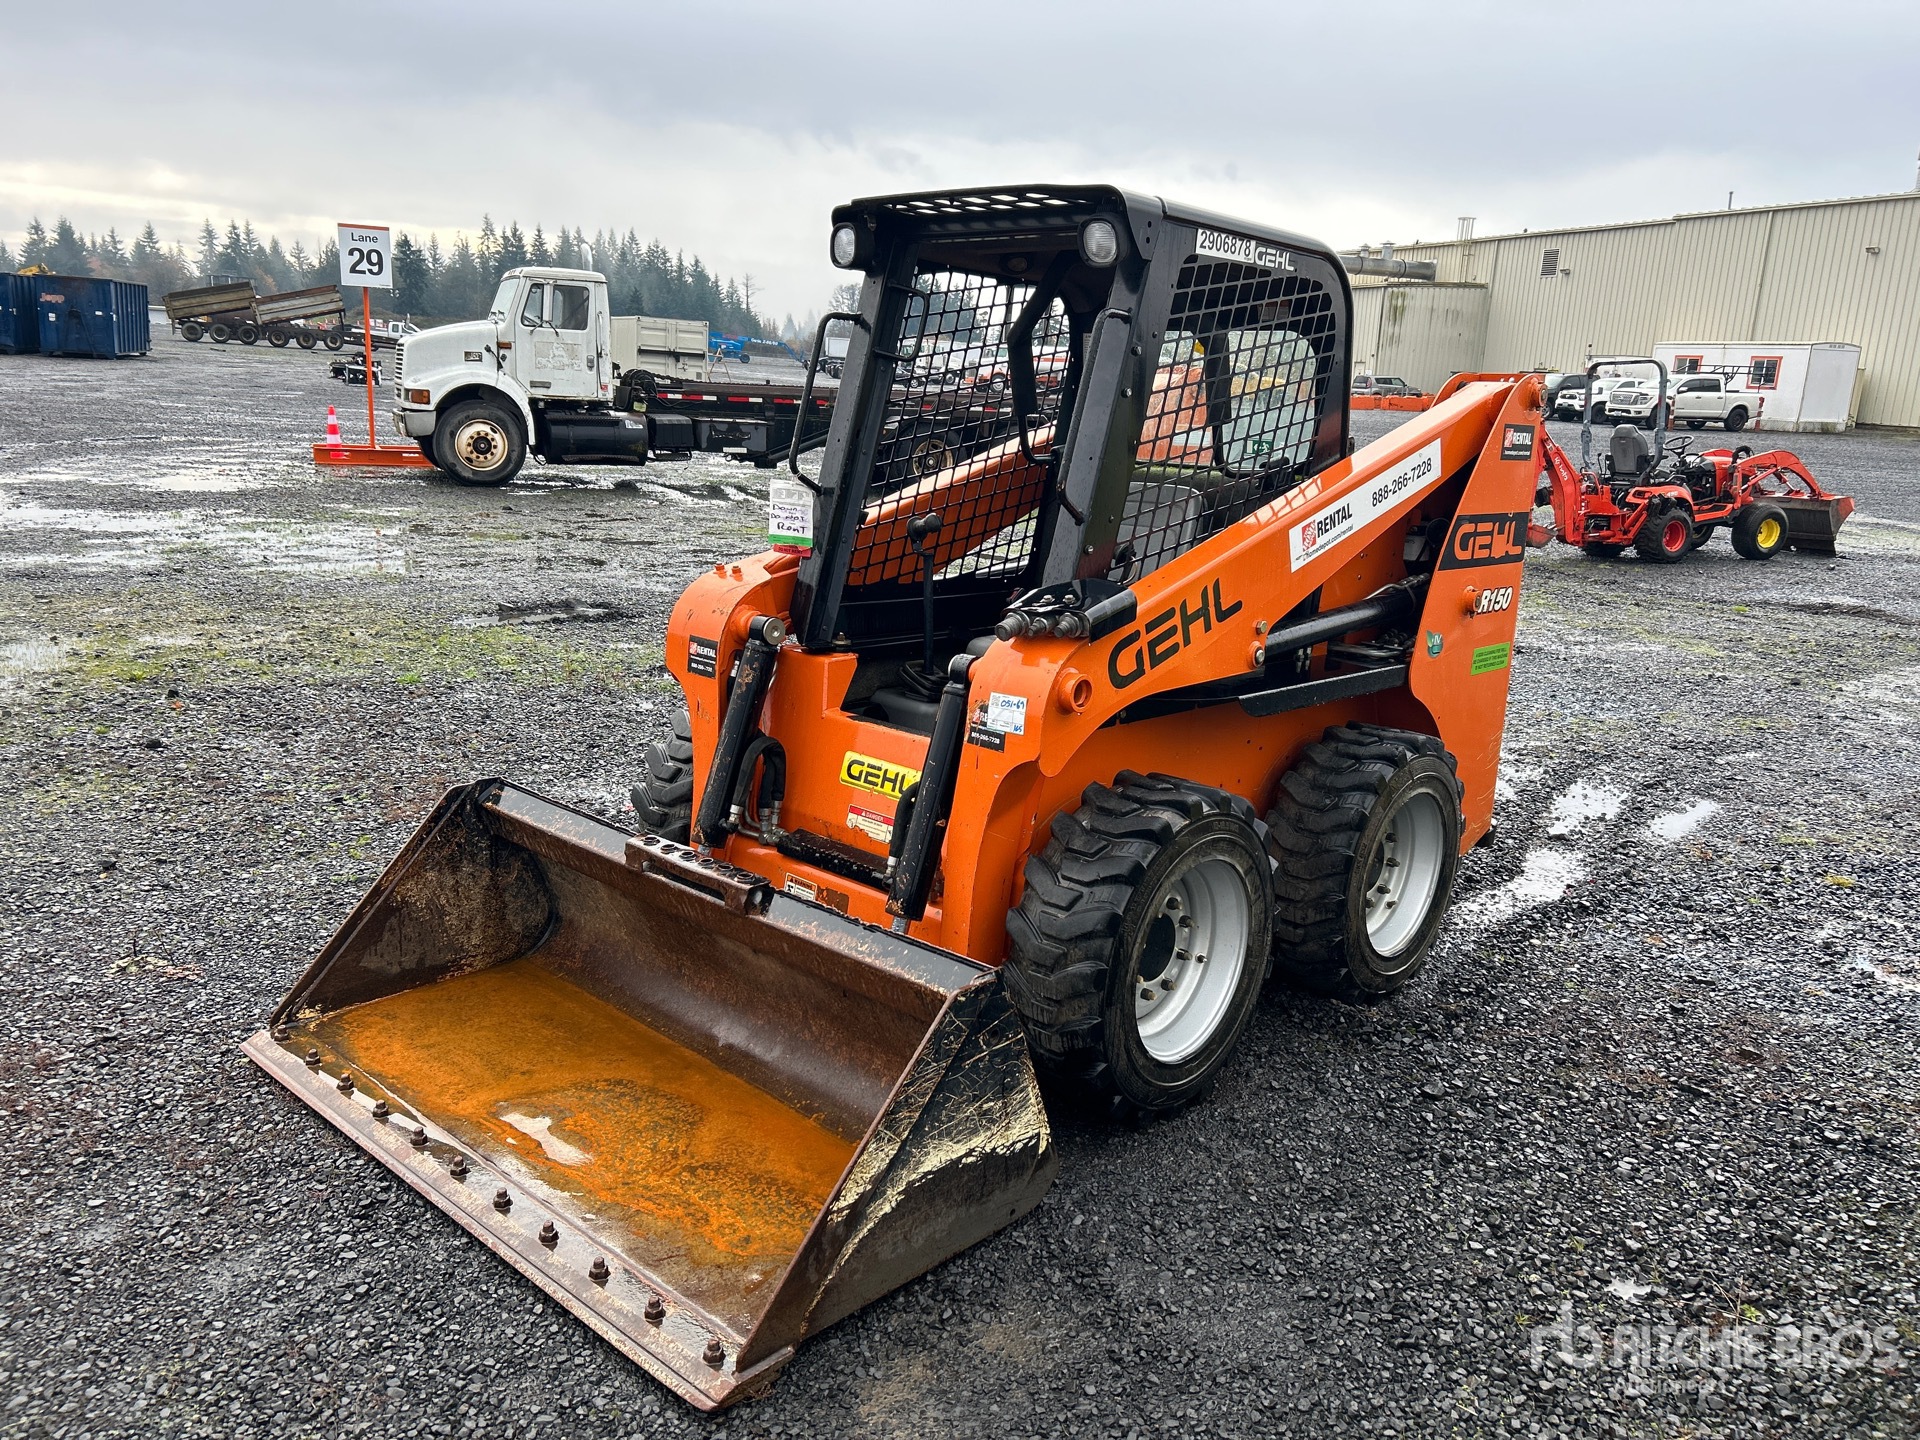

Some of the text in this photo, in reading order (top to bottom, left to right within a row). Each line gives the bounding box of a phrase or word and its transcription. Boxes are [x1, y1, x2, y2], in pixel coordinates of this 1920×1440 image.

[351, 232, 378, 243] Lane
[1199, 230, 1252, 258] 2906878
[348, 247, 384, 276] 29
[1255, 246, 1294, 271] GEHL
[1512, 432, 1532, 445] RENTAL
[1371, 457, 1433, 508] 888-266-7228
[1316, 502, 1353, 539] RENTAL
[1454, 520, 1522, 562] GEHL
[1477, 585, 1513, 615] R150
[1108, 577, 1243, 690] GEHL
[697, 645, 717, 658] RENTAL
